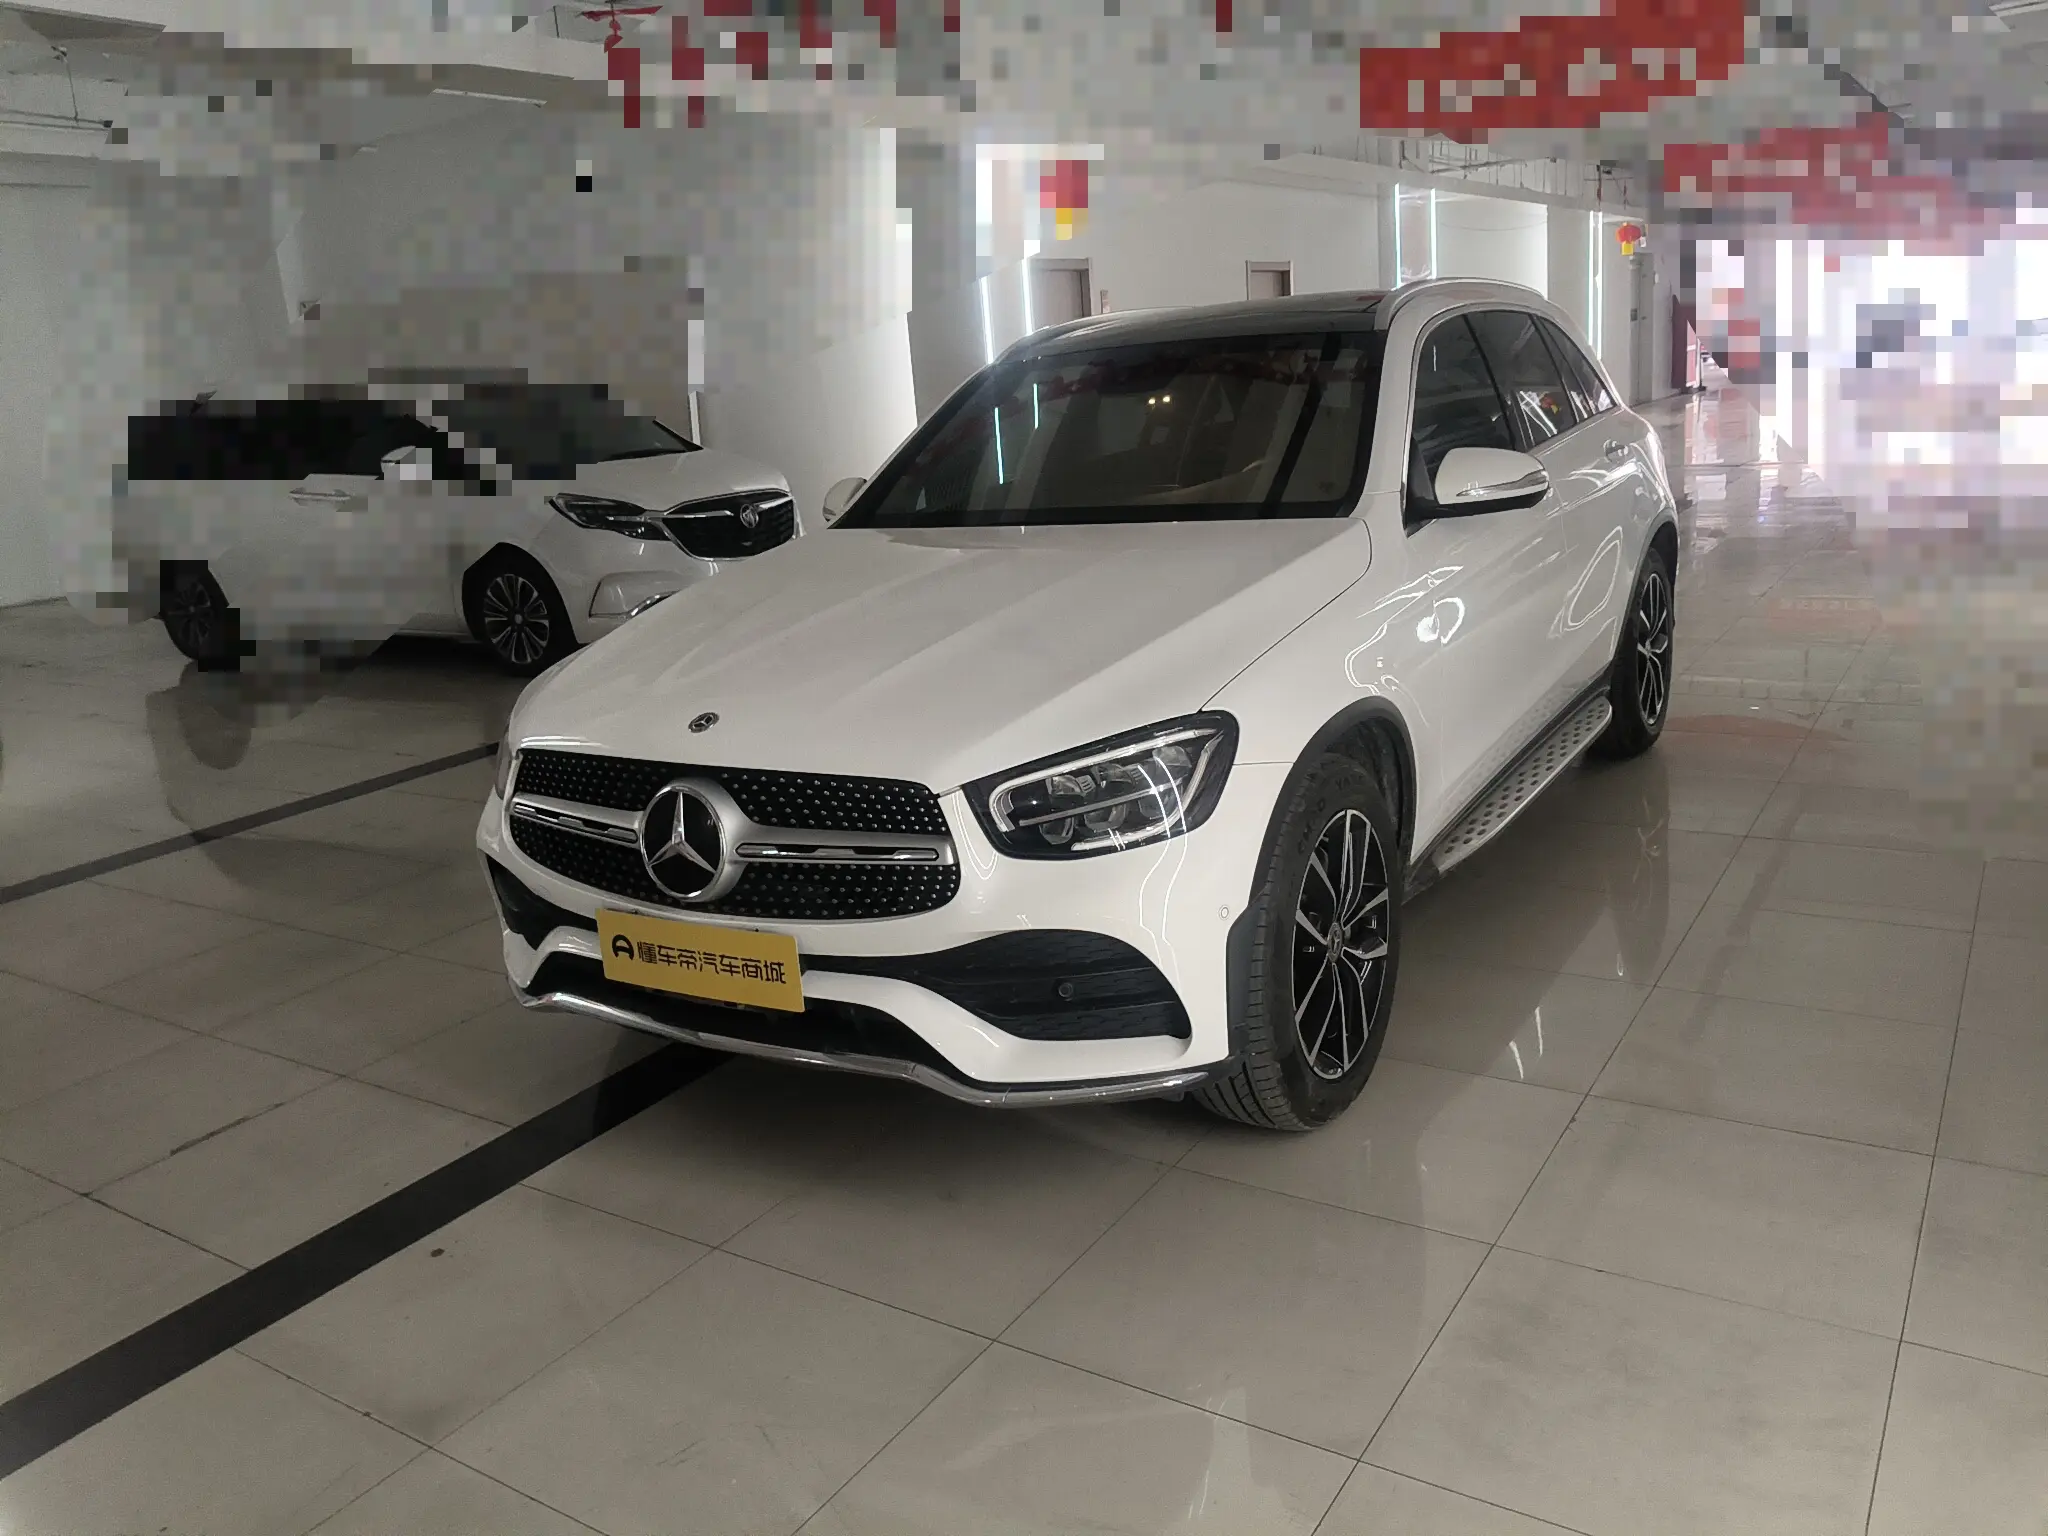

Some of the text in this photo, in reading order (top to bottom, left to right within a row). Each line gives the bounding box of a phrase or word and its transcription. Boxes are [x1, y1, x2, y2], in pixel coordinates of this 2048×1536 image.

[637, 941, 786, 984] 懂车帝汽车商城
